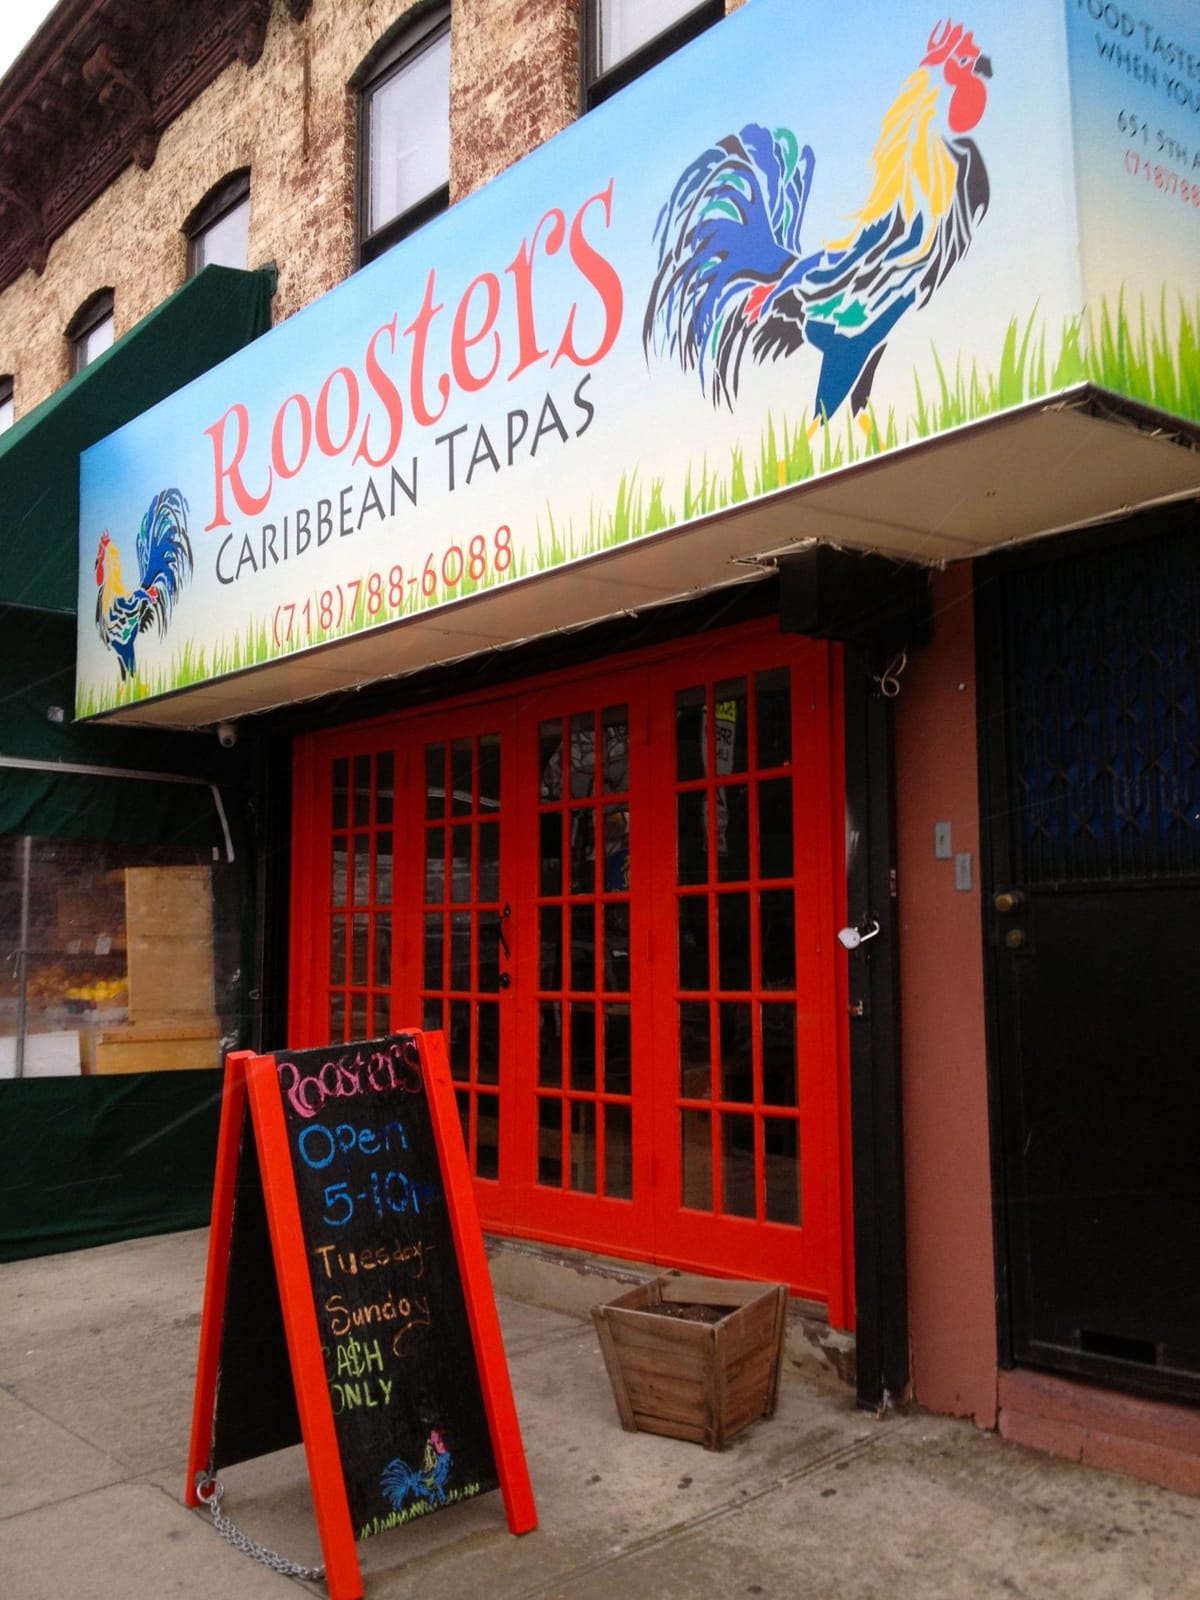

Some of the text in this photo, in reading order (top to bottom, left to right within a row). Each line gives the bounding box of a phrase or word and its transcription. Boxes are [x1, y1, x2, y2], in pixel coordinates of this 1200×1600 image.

[1095, 31, 1157, 88] WHEN
[1117, 108, 1149, 145] 651
[203, 176, 625, 533] Roosters
[215, 373, 596, 585] CARIBBEAN TAPAS
[272, 524, 514, 647] (718)788-6088
[276, 1039, 423, 1118] Roosters
[298, 1121, 408, 1172] Open
